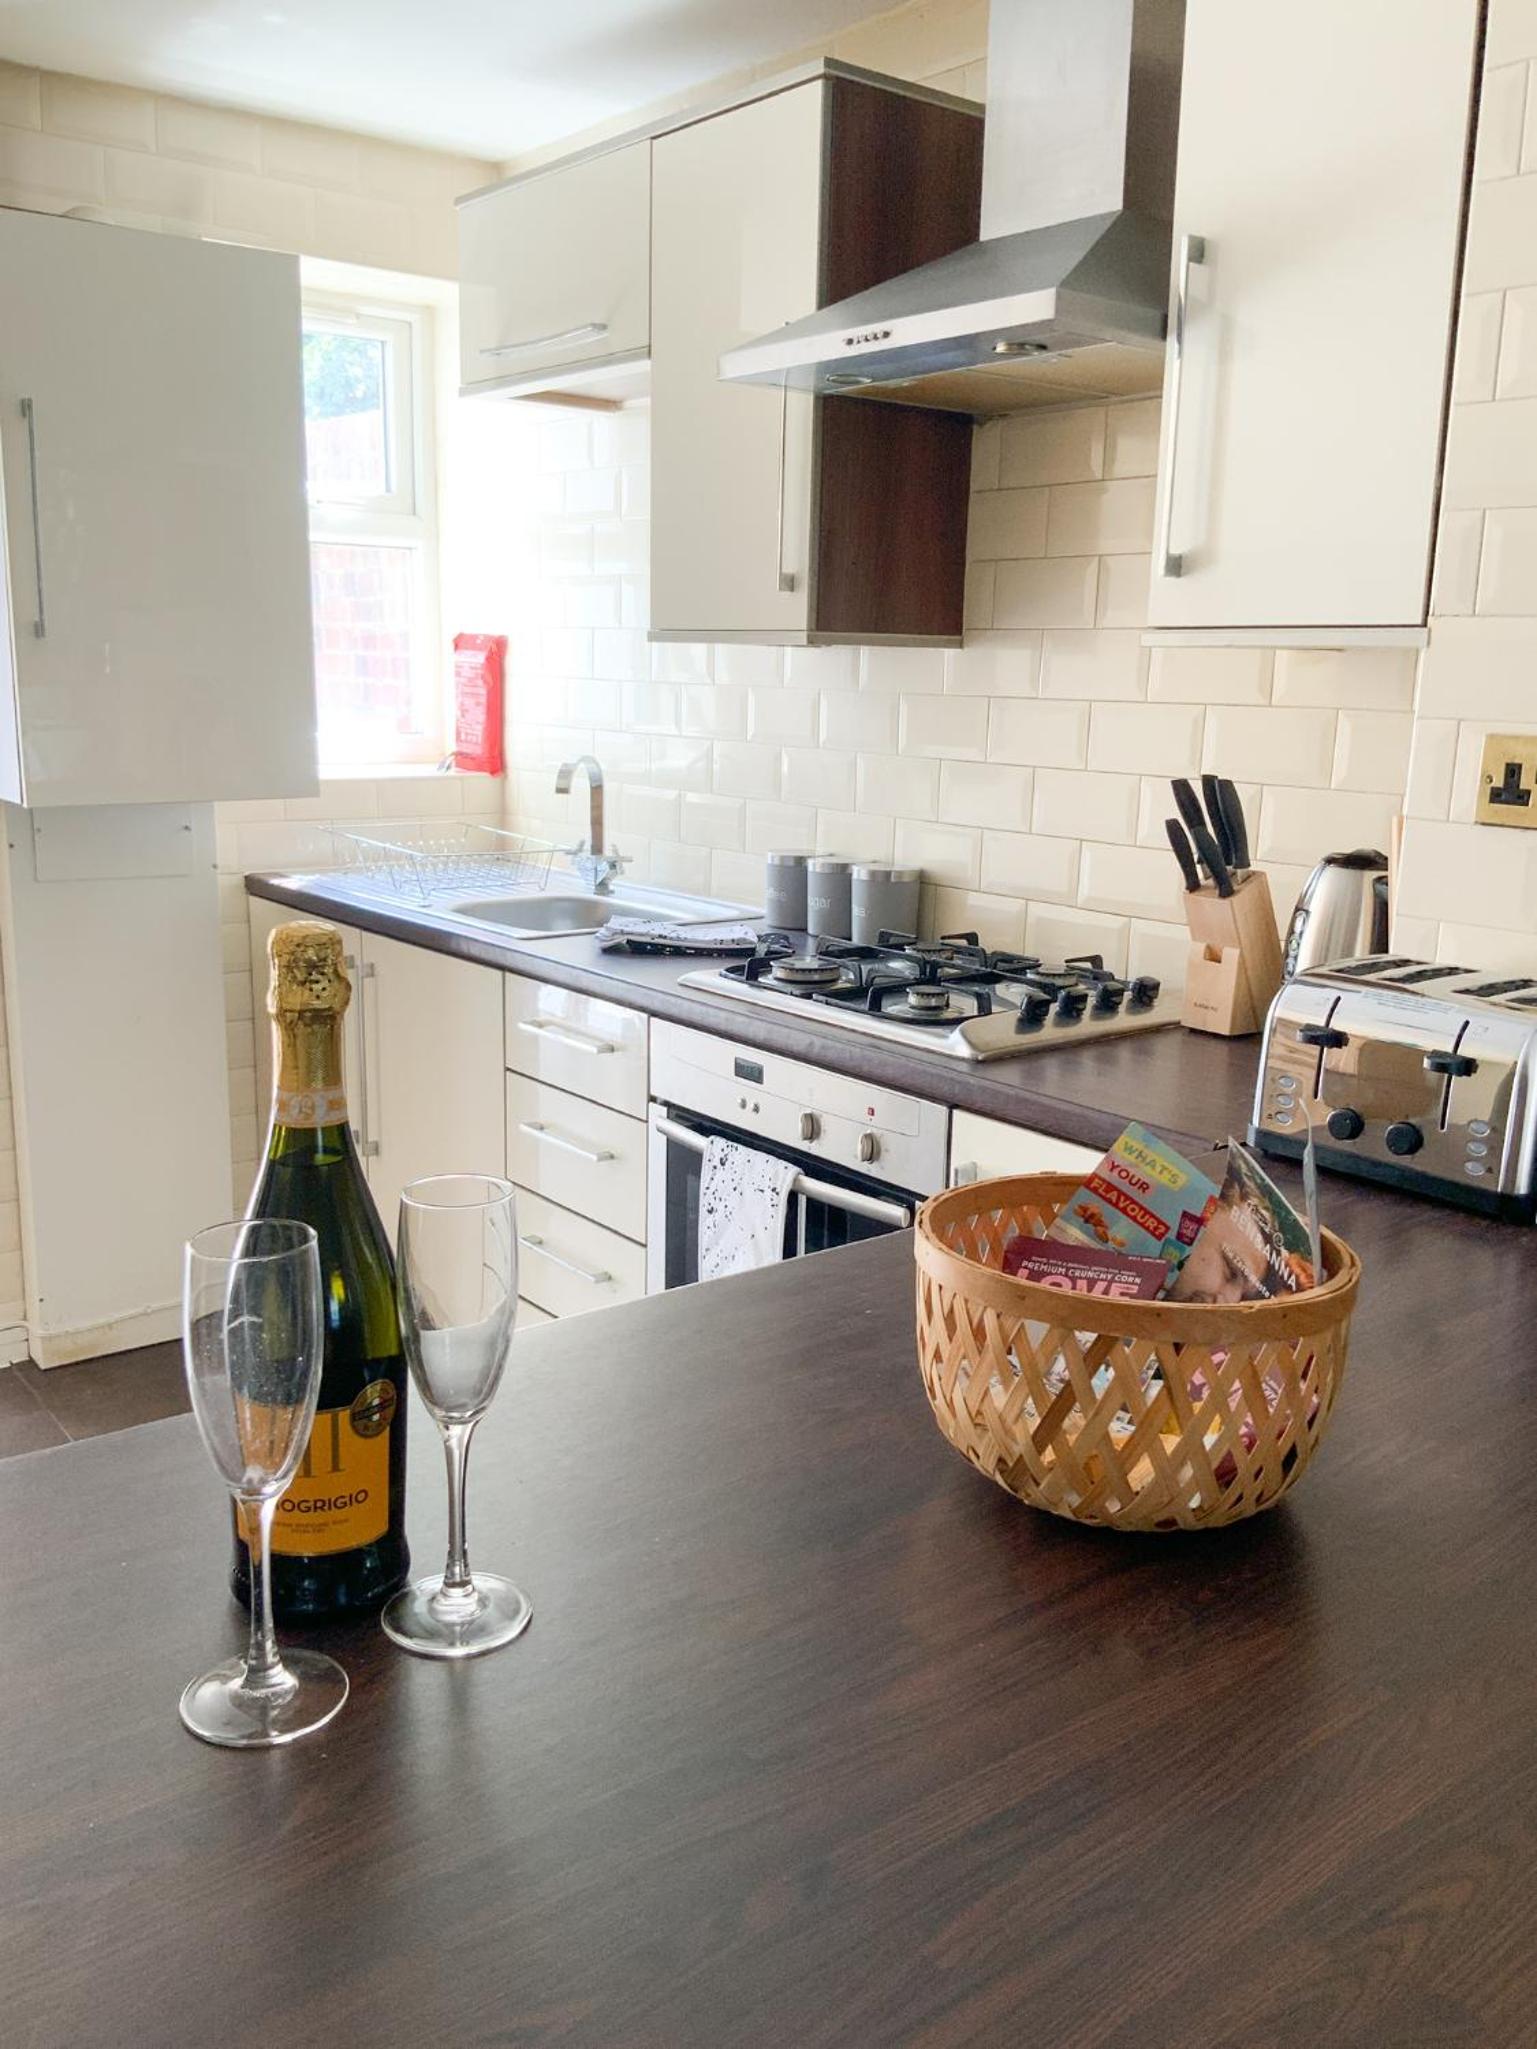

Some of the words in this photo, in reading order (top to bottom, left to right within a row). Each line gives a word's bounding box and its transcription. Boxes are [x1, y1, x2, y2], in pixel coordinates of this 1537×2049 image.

[1108, 1160, 1150, 1194] YOUR
[1122, 1139, 1180, 1186] WHAT'S
[1090, 1178, 1167, 1236] FLAVOUR?
[1022, 1260, 1066, 1276] PREMIUM
[1068, 1268, 1113, 1281] CRUNCHY
[1114, 1274, 1143, 1285] CORN
